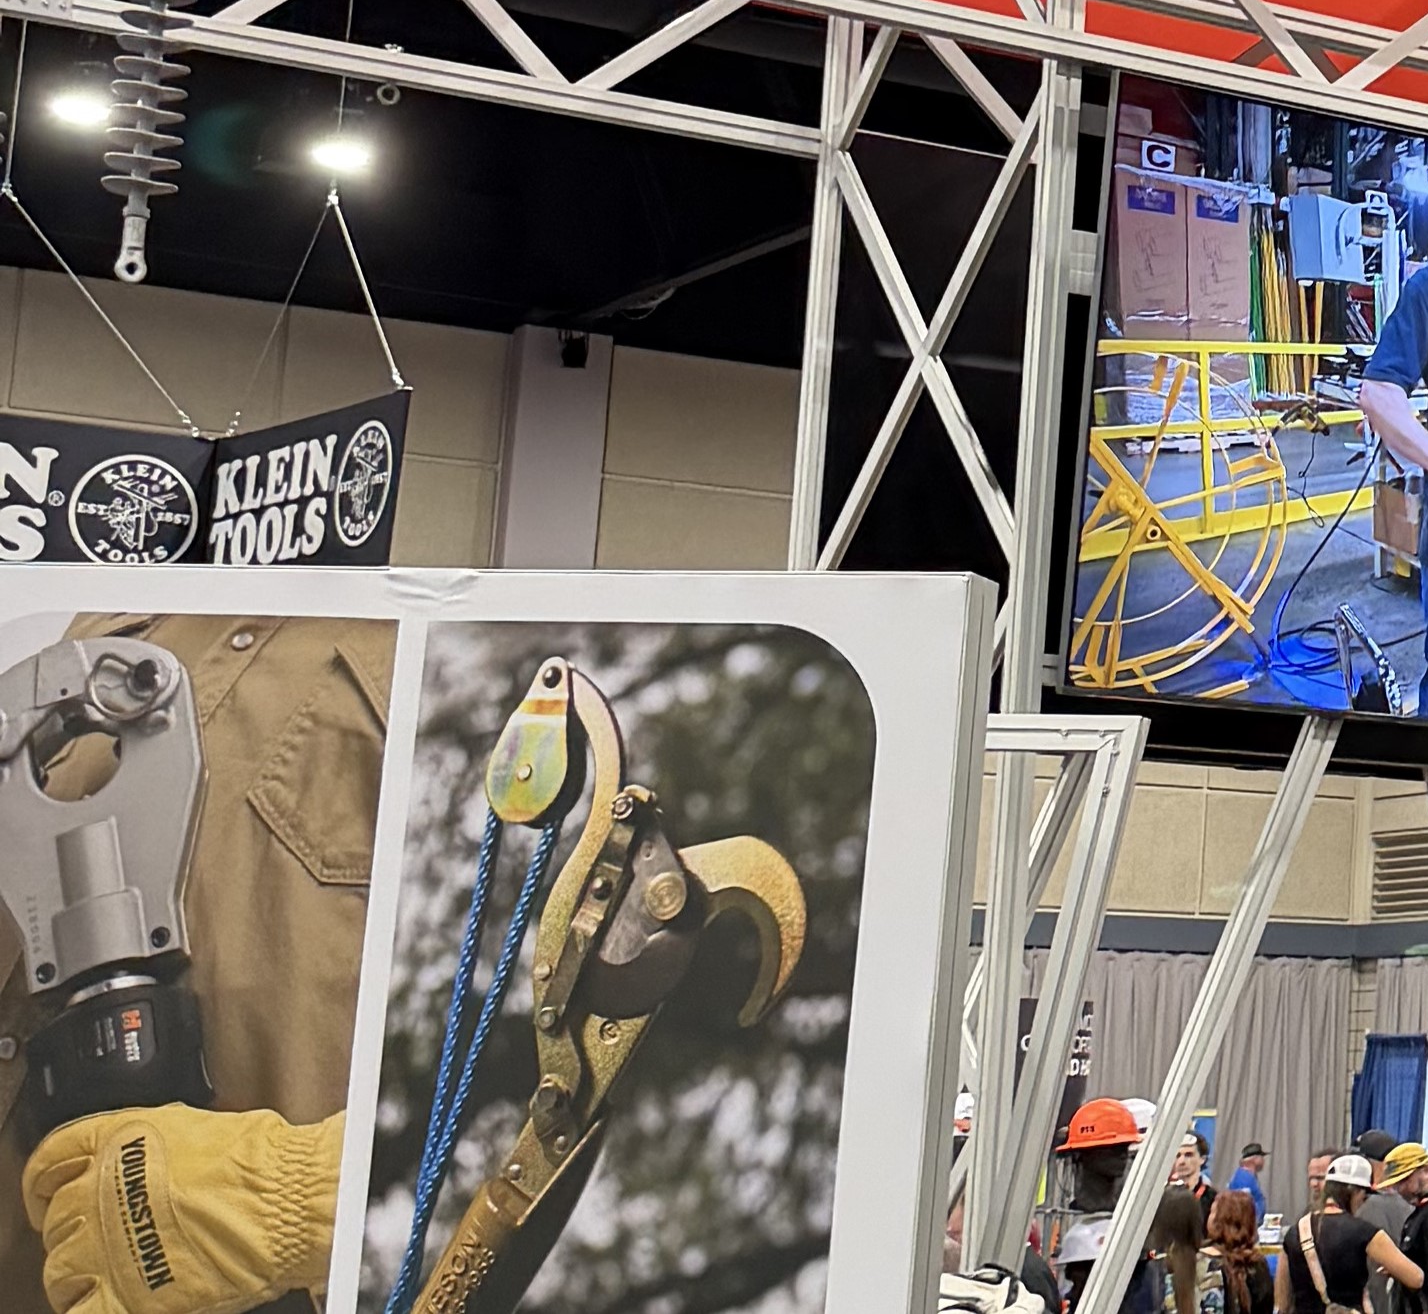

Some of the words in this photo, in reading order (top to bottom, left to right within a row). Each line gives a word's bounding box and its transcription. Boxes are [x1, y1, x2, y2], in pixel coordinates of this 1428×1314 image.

[1146, 144, 1172, 168] C
[100, 464, 179, 492] KLEIN
[212, 434, 338, 519] KLEIN
[93, 539, 169, 564] TOOLS
[209, 496, 328, 565] TOOLS
[121, 1135, 175, 1292] YOUNGSTOWN
